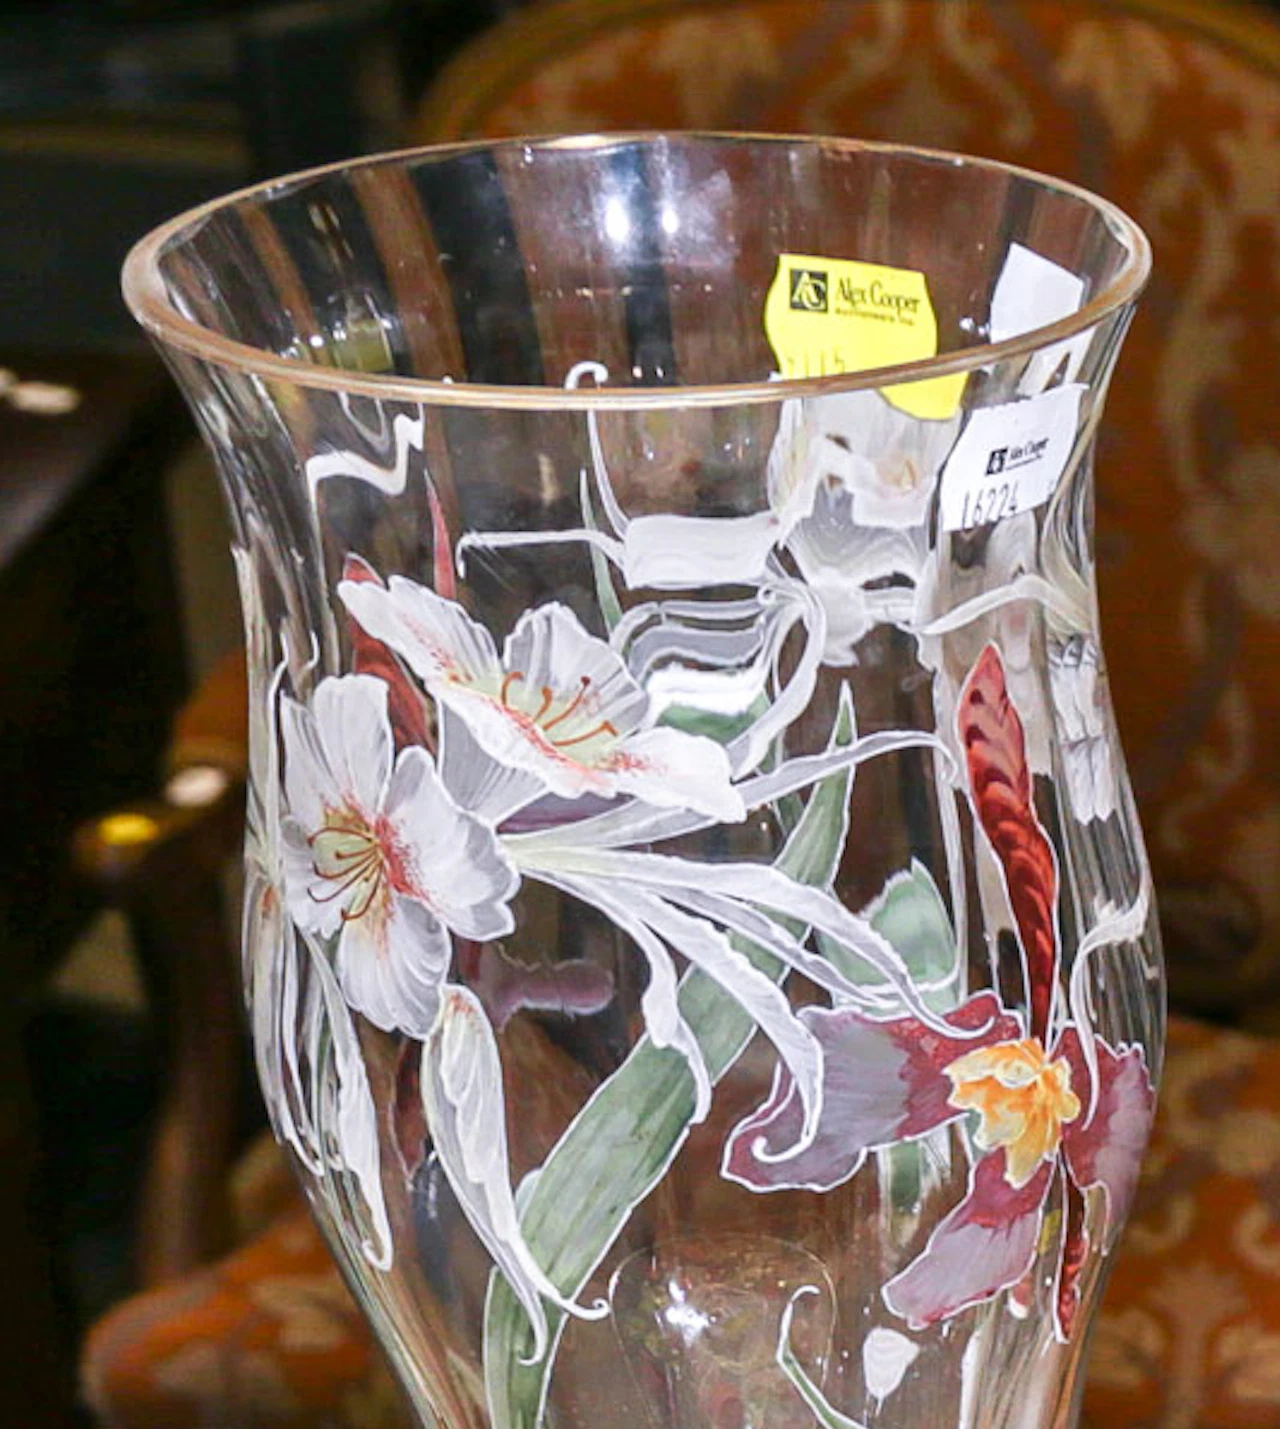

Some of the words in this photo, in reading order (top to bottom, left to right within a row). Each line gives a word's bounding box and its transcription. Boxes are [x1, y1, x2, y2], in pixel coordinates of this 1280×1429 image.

[836, 277, 867, 308] Alex
[870, 279, 920, 317] Cooper
[961, 483, 1018, 530] 16224
